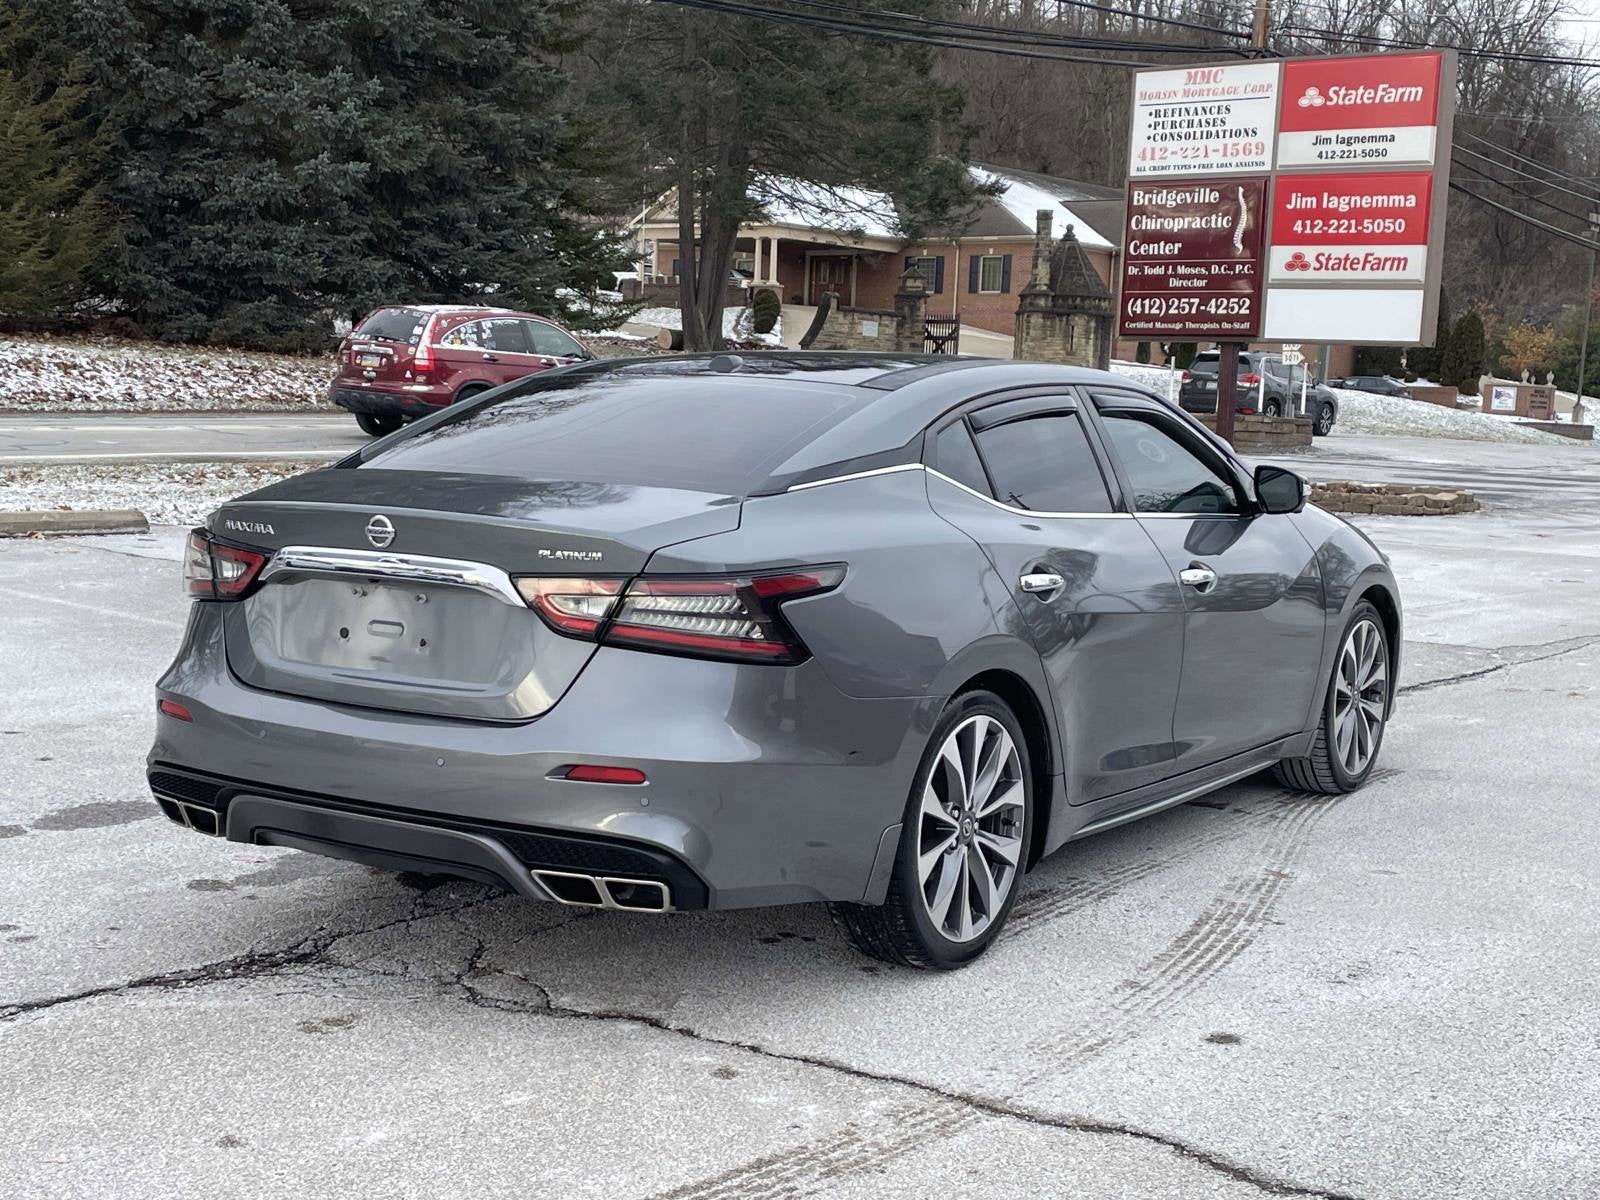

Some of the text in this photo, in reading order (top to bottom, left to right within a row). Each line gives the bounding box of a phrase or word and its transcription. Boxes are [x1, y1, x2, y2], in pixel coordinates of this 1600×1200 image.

[1184, 69, 1224, 85] MMC
[1181, 85, 1240, 98] MORTGAGE
[1154, 104, 1232, 118] REFINANCES
[1153, 117, 1227, 130] PURCHASES
[1152, 127, 1258, 142] CONSOLIDATIONS
[1312, 135, 1332, 146] Jim
[1138, 141, 1265, 161] 412-221-1569
[1317, 148, 1388, 160] 412-221-5050
[1173, 163, 1192, 171] TYPES
[1235, 160, 1266, 168] ANALYSIS
[1133, 188, 1220, 208] Bridgeville
[1286, 192, 1317, 209] Jim
[1130, 212, 1232, 232] Chiropractic
[1292, 218, 1406, 234] 412-221-5050
[1129, 240, 1182, 256] Center
[1128, 265, 1141, 275] Dr.
[1143, 265, 1165, 275] Todd
[1167, 265, 1175, 275] J.
[1177, 264, 1209, 276] Moses,
[1235, 264, 1254, 274] P.C.
[1169, 277, 1208, 287] Director
[1125, 321, 1250, 331] Certified Massage Therapists On-Staff
[225, 519, 275, 535] MAXIMA
[538, 549, 602, 561] PLATINUM
